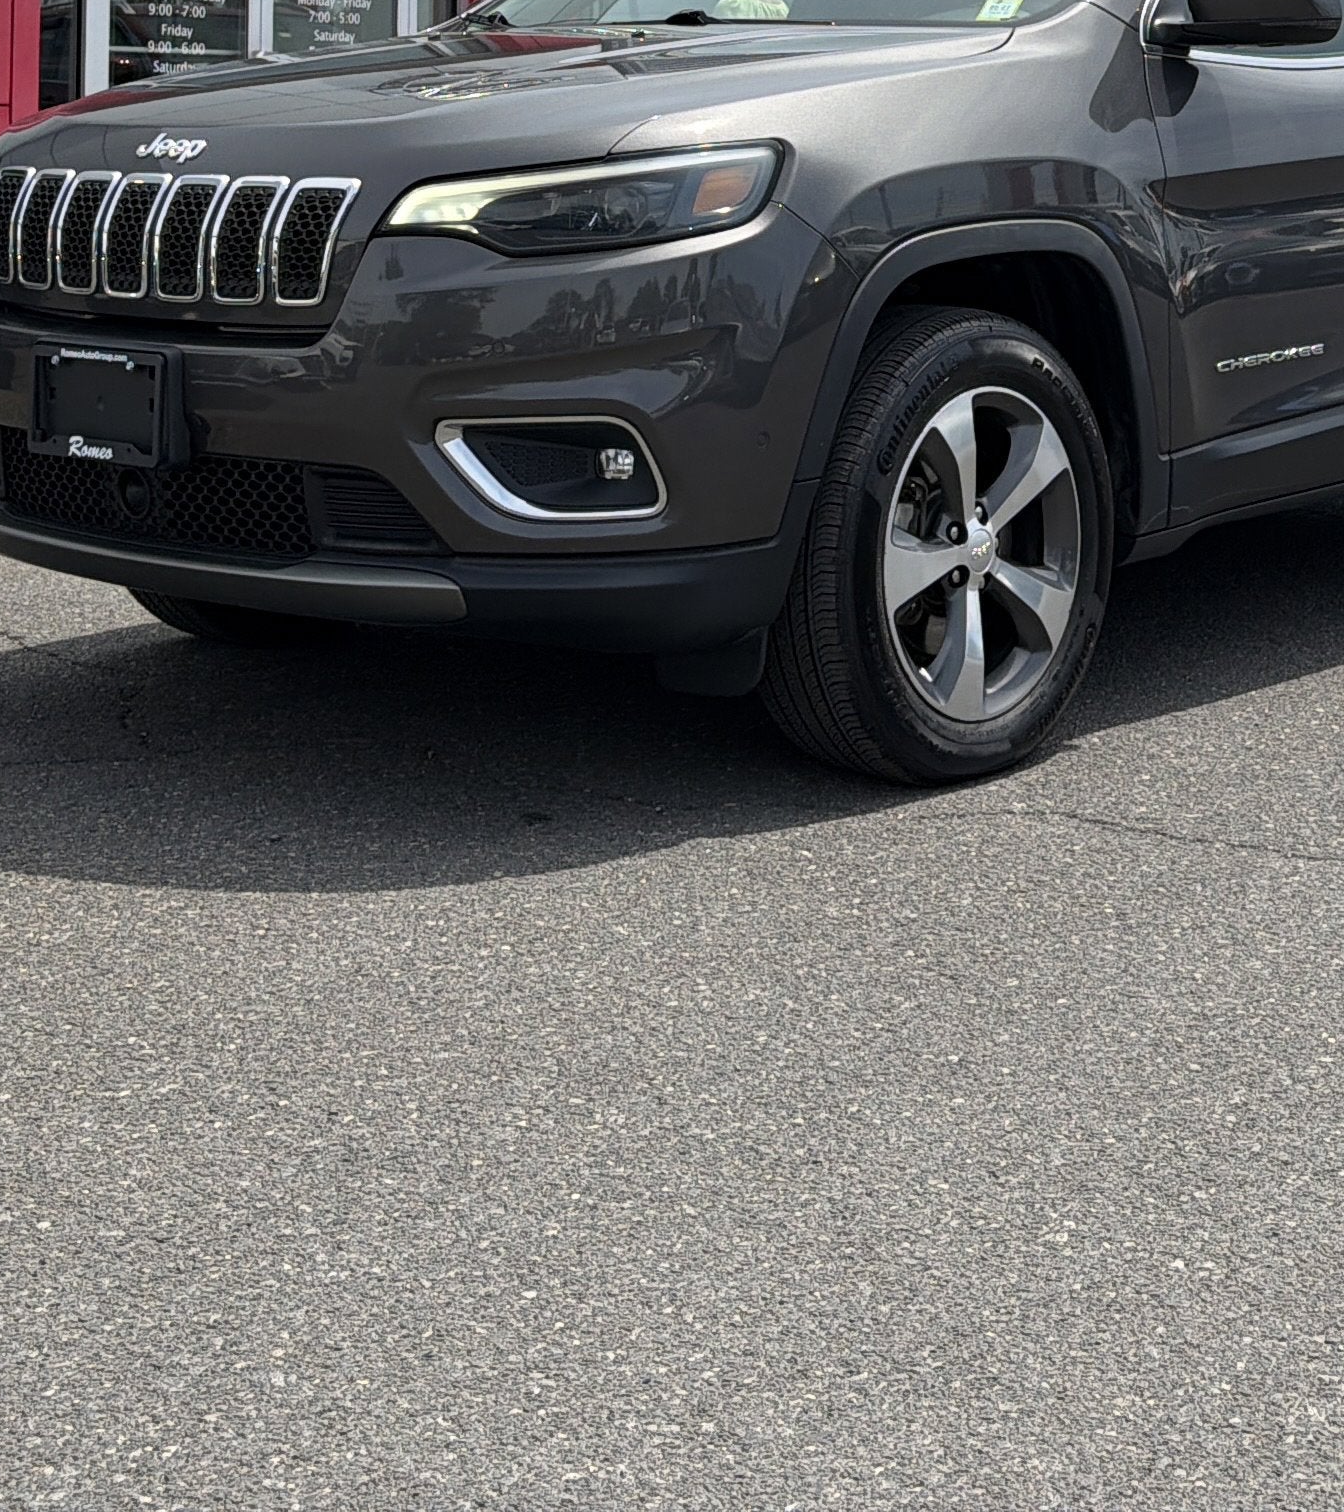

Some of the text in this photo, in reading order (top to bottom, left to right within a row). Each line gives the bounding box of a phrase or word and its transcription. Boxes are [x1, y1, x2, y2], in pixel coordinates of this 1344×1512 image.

[148, 3, 173, 16] 9:00
[181, 5, 207, 18] 7:00
[309, 10, 331, 23] 7:00
[339, 11, 361, 25] 5:00
[161, 23, 193, 39] Friday
[313, 29, 356, 45] Saturday
[147, 40, 172, 54] 9:00
[181, 42, 206, 55] 6:00
[153, 59, 196, 74] Saturd
[136, 132, 207, 164] Jeep
[1216, 343, 1324, 372] CHEROKEE
[67, 435, 114, 460] Romeo
